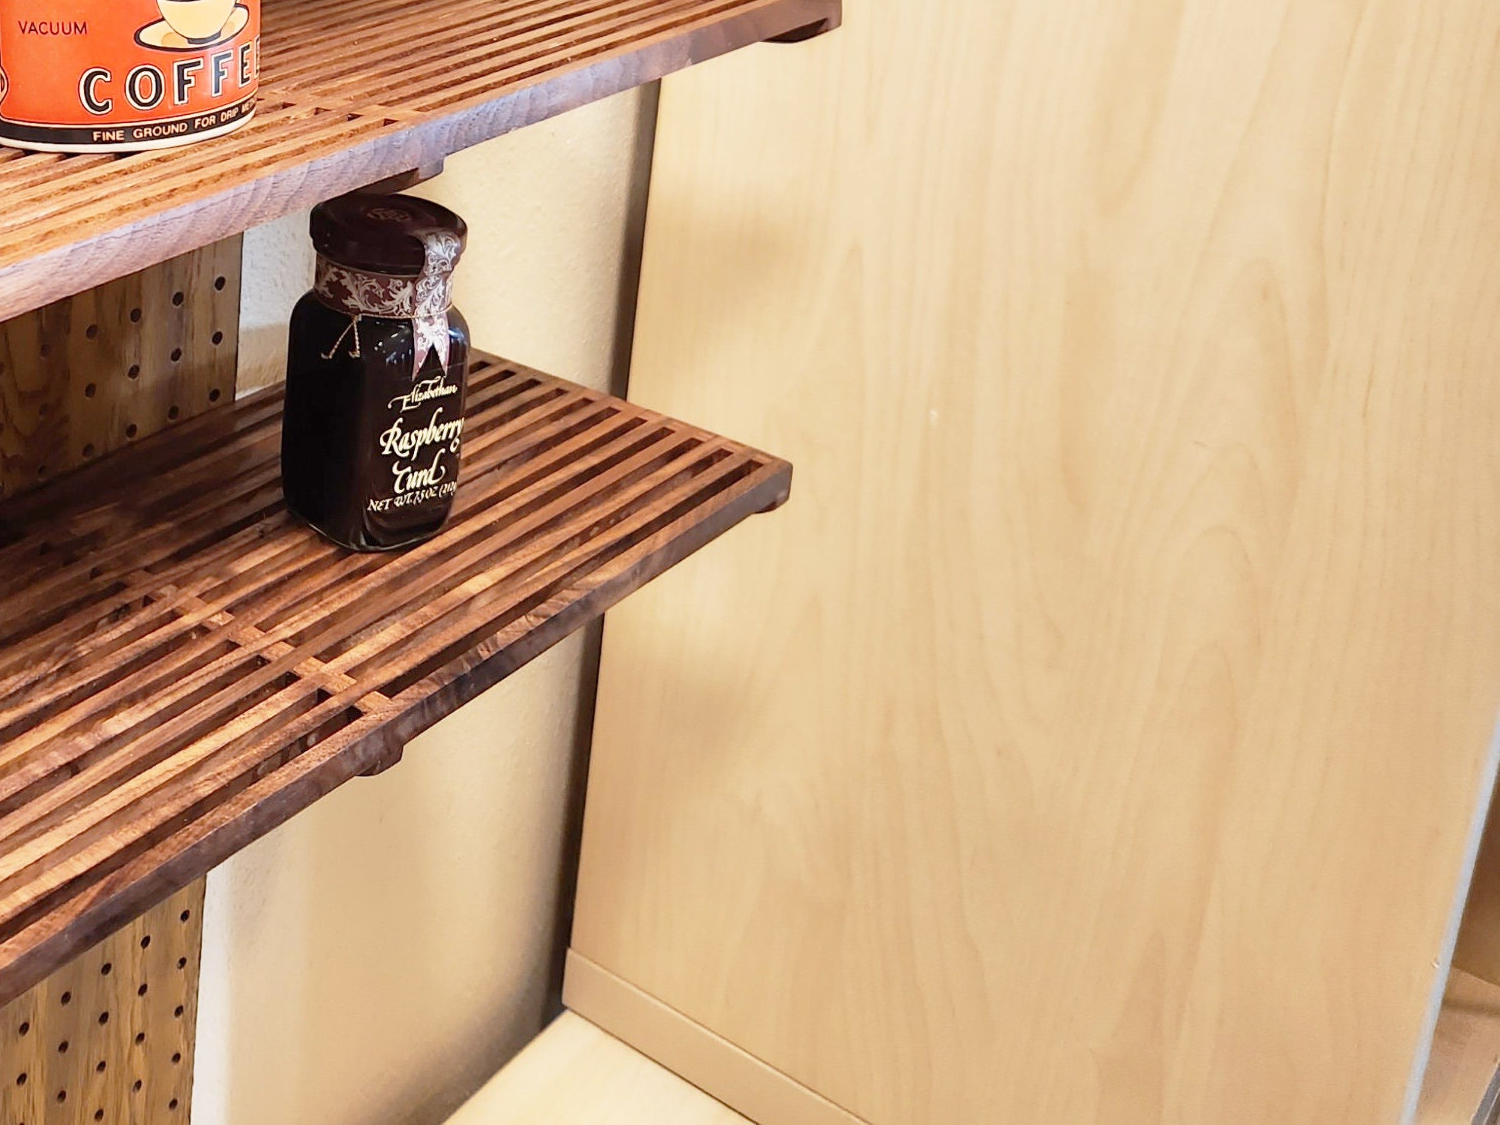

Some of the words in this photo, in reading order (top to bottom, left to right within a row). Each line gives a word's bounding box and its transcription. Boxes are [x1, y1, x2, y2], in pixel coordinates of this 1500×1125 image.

[18, 21, 88, 35] VACUUM
[93, 129, 125, 142] FINE
[132, 122, 188, 138] GROUND
[194, 115, 216, 129] FOR
[220, 107, 239, 122] DRIP
[387, 376, 458, 413] Elizabethan
[379, 407, 465, 461] Raspberry
[392, 448, 446, 494] Curd
[367, 497, 393, 512] NET
